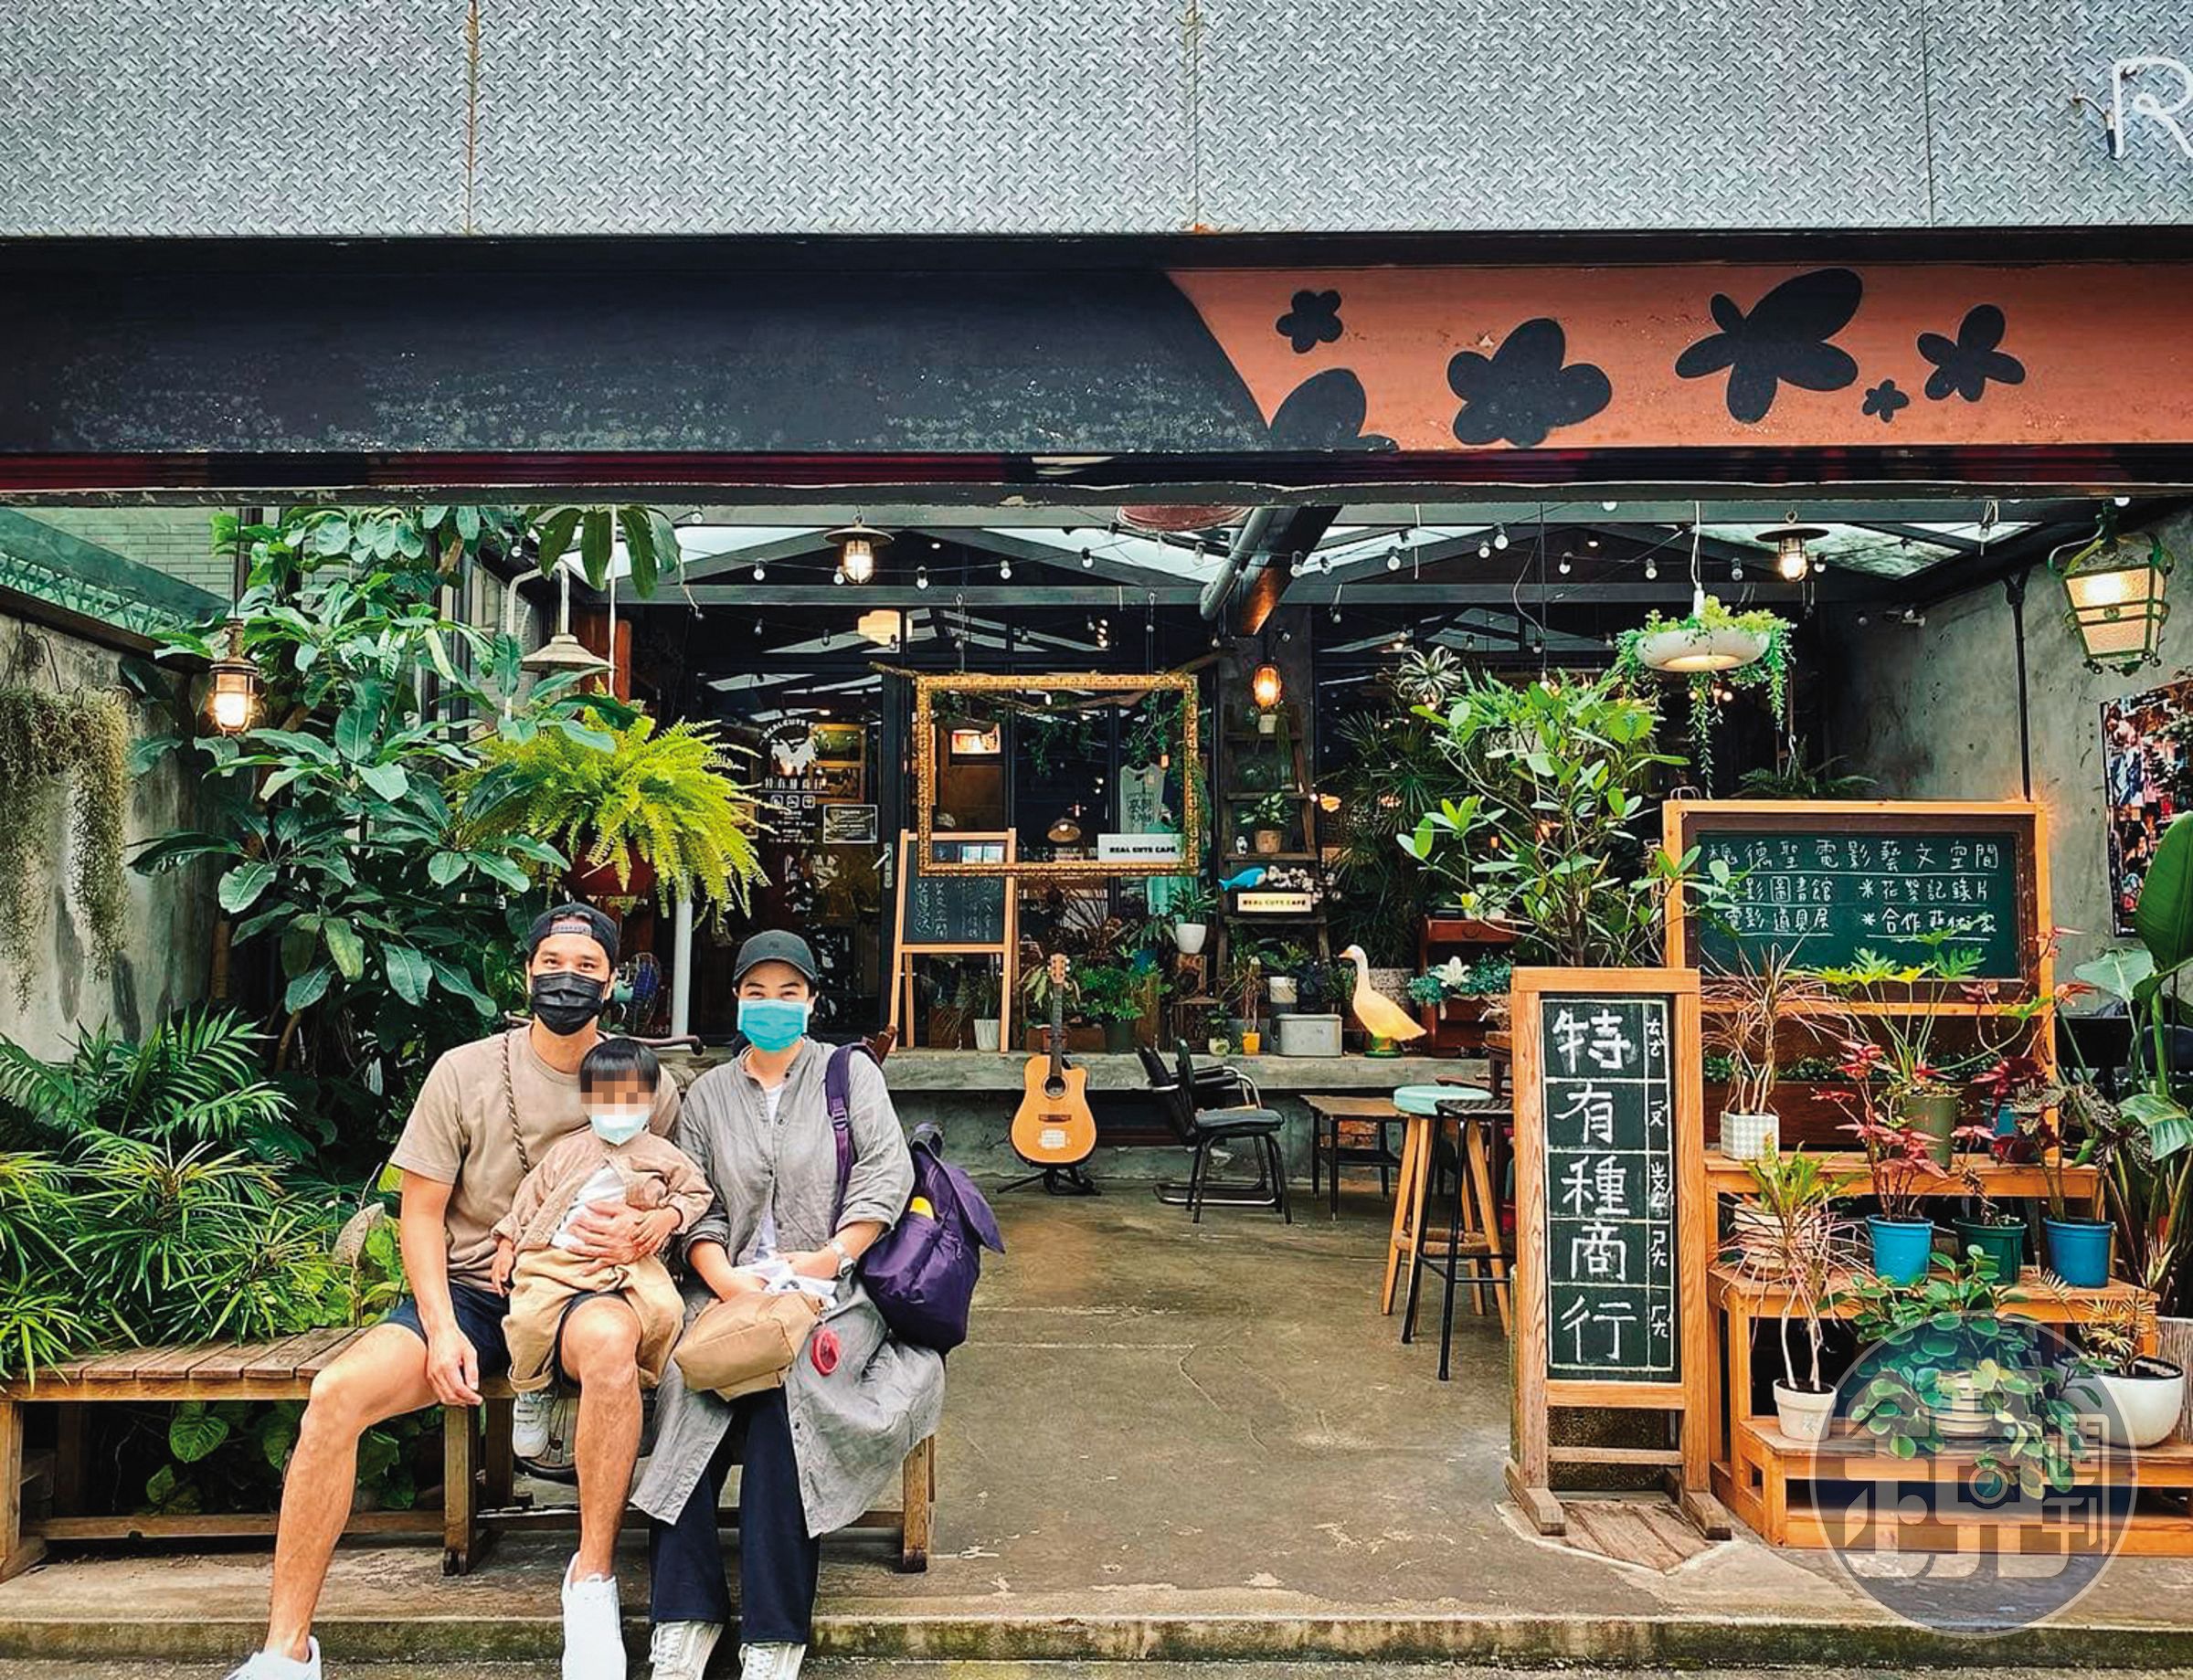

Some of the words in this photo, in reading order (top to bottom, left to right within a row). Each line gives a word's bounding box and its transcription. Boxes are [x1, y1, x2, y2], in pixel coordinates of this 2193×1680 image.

[1552, 1008, 1637, 1364] 特有種商行
